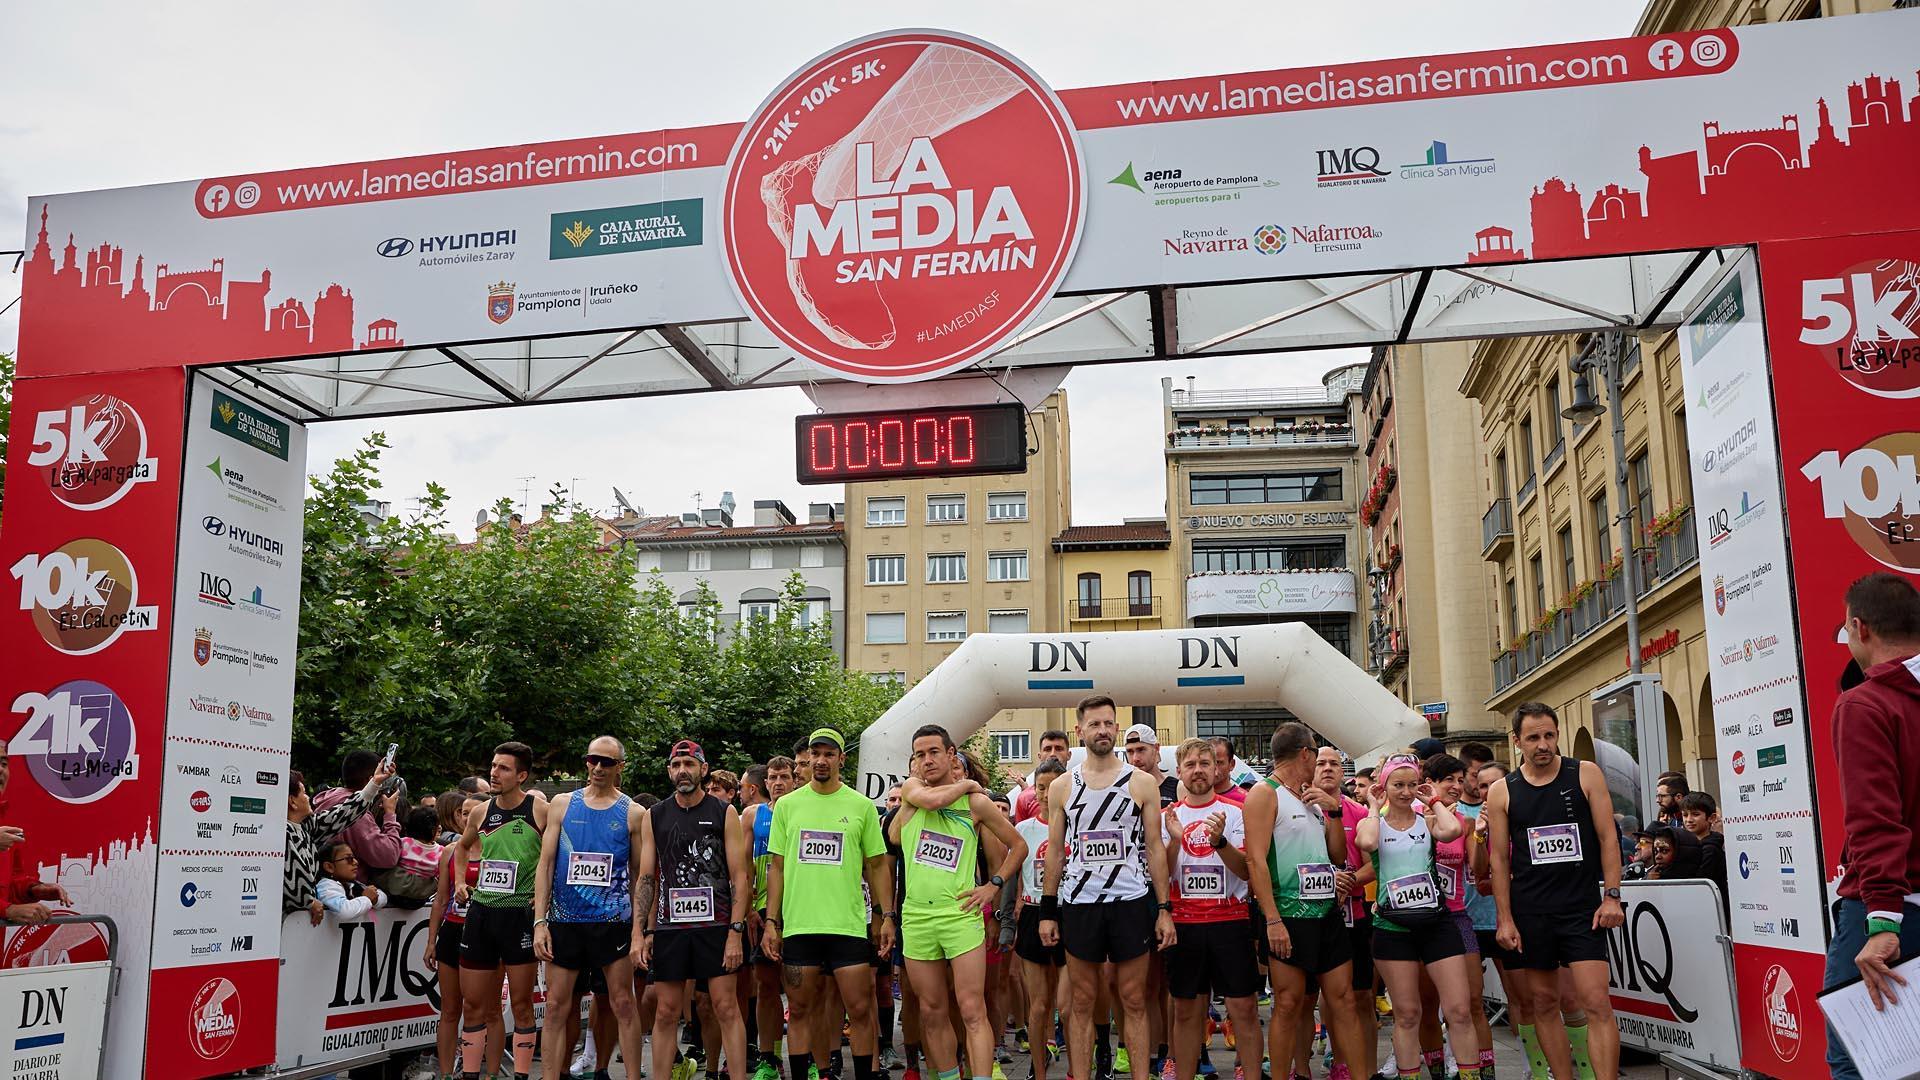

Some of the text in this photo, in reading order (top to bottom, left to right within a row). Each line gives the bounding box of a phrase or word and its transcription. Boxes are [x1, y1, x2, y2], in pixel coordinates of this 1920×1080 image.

[1117, 53, 1627, 119] www.lamediasanfermin.com
[765, 59, 881, 155] 21K 10K 5K
[856, 136, 952, 197] LA
[1316, 146, 1391, 176] IMQ
[277, 142, 698, 204] www.lamediasanfermin.com
[1144, 168, 1182, 181] aena
[1400, 163, 1496, 180] Clínica San Miguel
[1153, 175, 1259, 190] Aeropuerto de Pamplona
[1317, 180, 1352, 189] IGUALATORIO
[1361, 177, 1387, 185] NAVARRA
[1155, 192, 1241, 206] aeropuertos para ti
[600, 215, 680, 234] CAJA RURAL
[790, 185, 1034, 259] MEDIA
[420, 230, 516, 253] HYUNDAI
[600, 226, 686, 245] DE NAVARRA
[1183, 227, 1228, 241] Reyno de
[1291, 224, 1383, 244] Nafarroako
[1164, 236, 1249, 256] Navarra
[1314, 242, 1362, 253] Erresuma
[419, 251, 515, 267] Automóviles Zaray
[835, 240, 1037, 284] SAN FERMÍN
[519, 289, 571, 301] Ayuntamiento
[590, 283, 639, 297] Iruñeko
[518, 298, 581, 312] Pamplona
[589, 297, 612, 305] Udala
[1799, 273, 1919, 346] 5k
[917, 289, 1001, 343] #LAMEDIASF
[238, 412, 279, 437] CAJA RURAL
[27, 405, 109, 466] 5k
[237, 421, 248, 433] DE
[249, 427, 281, 448] NAVARRA
[1718, 418, 1757, 460] HYUNDAI
[51, 468, 70, 487] La
[224, 468, 244, 482] aena
[228, 480, 252, 494] Aeropuerto
[258, 491, 277, 504] Pamplona
[1202, 511, 1348, 527] NUEVO CASINO ESLAVA
[1708, 508, 1732, 539] IMQ
[229, 525, 283, 556] HYUNDAI
[228, 543, 282, 568] Automóviles Zaray
[1752, 562, 1772, 580] Iruñeko
[10, 551, 110, 610] 10k
[200, 571, 236, 605] IMQ
[1726, 583, 1751, 601] Pamplona
[239, 601, 255, 615] Clínica
[255, 607, 264, 615] San
[264, 608, 281, 620] Miguel
[212, 650, 249, 665] Pamplona
[213, 642, 243, 655] Ayuntamiento
[1028, 641, 1091, 673] DN
[1177, 636, 1241, 669] DN
[253, 652, 278, 665] Iruñeko
[1720, 649, 1743, 667] Navarra
[190, 698, 225, 715] Navarra
[8, 691, 104, 755] 21k
[1725, 724, 1742, 736] AMBAR
[1748, 724, 1763, 736] ALEA
[61, 759, 81, 781] La
[183, 766, 210, 777] AMBAR
[220, 774, 241, 784] ALEA
[1739, 784, 1755, 793] VITAMIN
[1763, 779, 1783, 796] fronda
[1740, 794, 1750, 802] WELL
[197, 822, 222, 831] VITAMIN
[197, 830, 212, 838] WELL
[232, 822, 258, 836] fronda
[805, 842, 836, 856] 21091
[922, 843, 953, 862] 21203
[1086, 843, 1118, 857] 21014
[1537, 838, 1573, 854] 21392
[1779, 846, 1793, 864] DN
[485, 872, 509, 884] 21153
[573, 864, 606, 877] 21043
[242, 878, 258, 893] DN
[1187, 876, 1218, 890] 21015
[1305, 876, 1332, 890] 21442
[195, 890, 212, 899] COPE
[1397, 886, 1431, 904] 21464
[675, 901, 707, 913] 21445
[14, 936, 26, 951] 21K
[191, 942, 222, 954] brandOK
[328, 918, 441, 1012] IMQ
[1605, 901, 1698, 1023] MQ
[18, 987, 68, 1029] DN
[209, 1002, 224, 1017] LA
[1776, 994, 1786, 1011] LA
[198, 1014, 235, 1033] MEDIA
[1769, 1008, 1798, 1031] MEDIA
[204, 1028, 235, 1040] SAN FERMÍN
[322, 1019, 440, 1052] IGUALATORIO DE NAVAR
[1646, 1022, 1656, 1040] DE
[1657, 1024, 1695, 1050] NAVARRA
[13, 1053, 61, 1072] DIARIO DE
